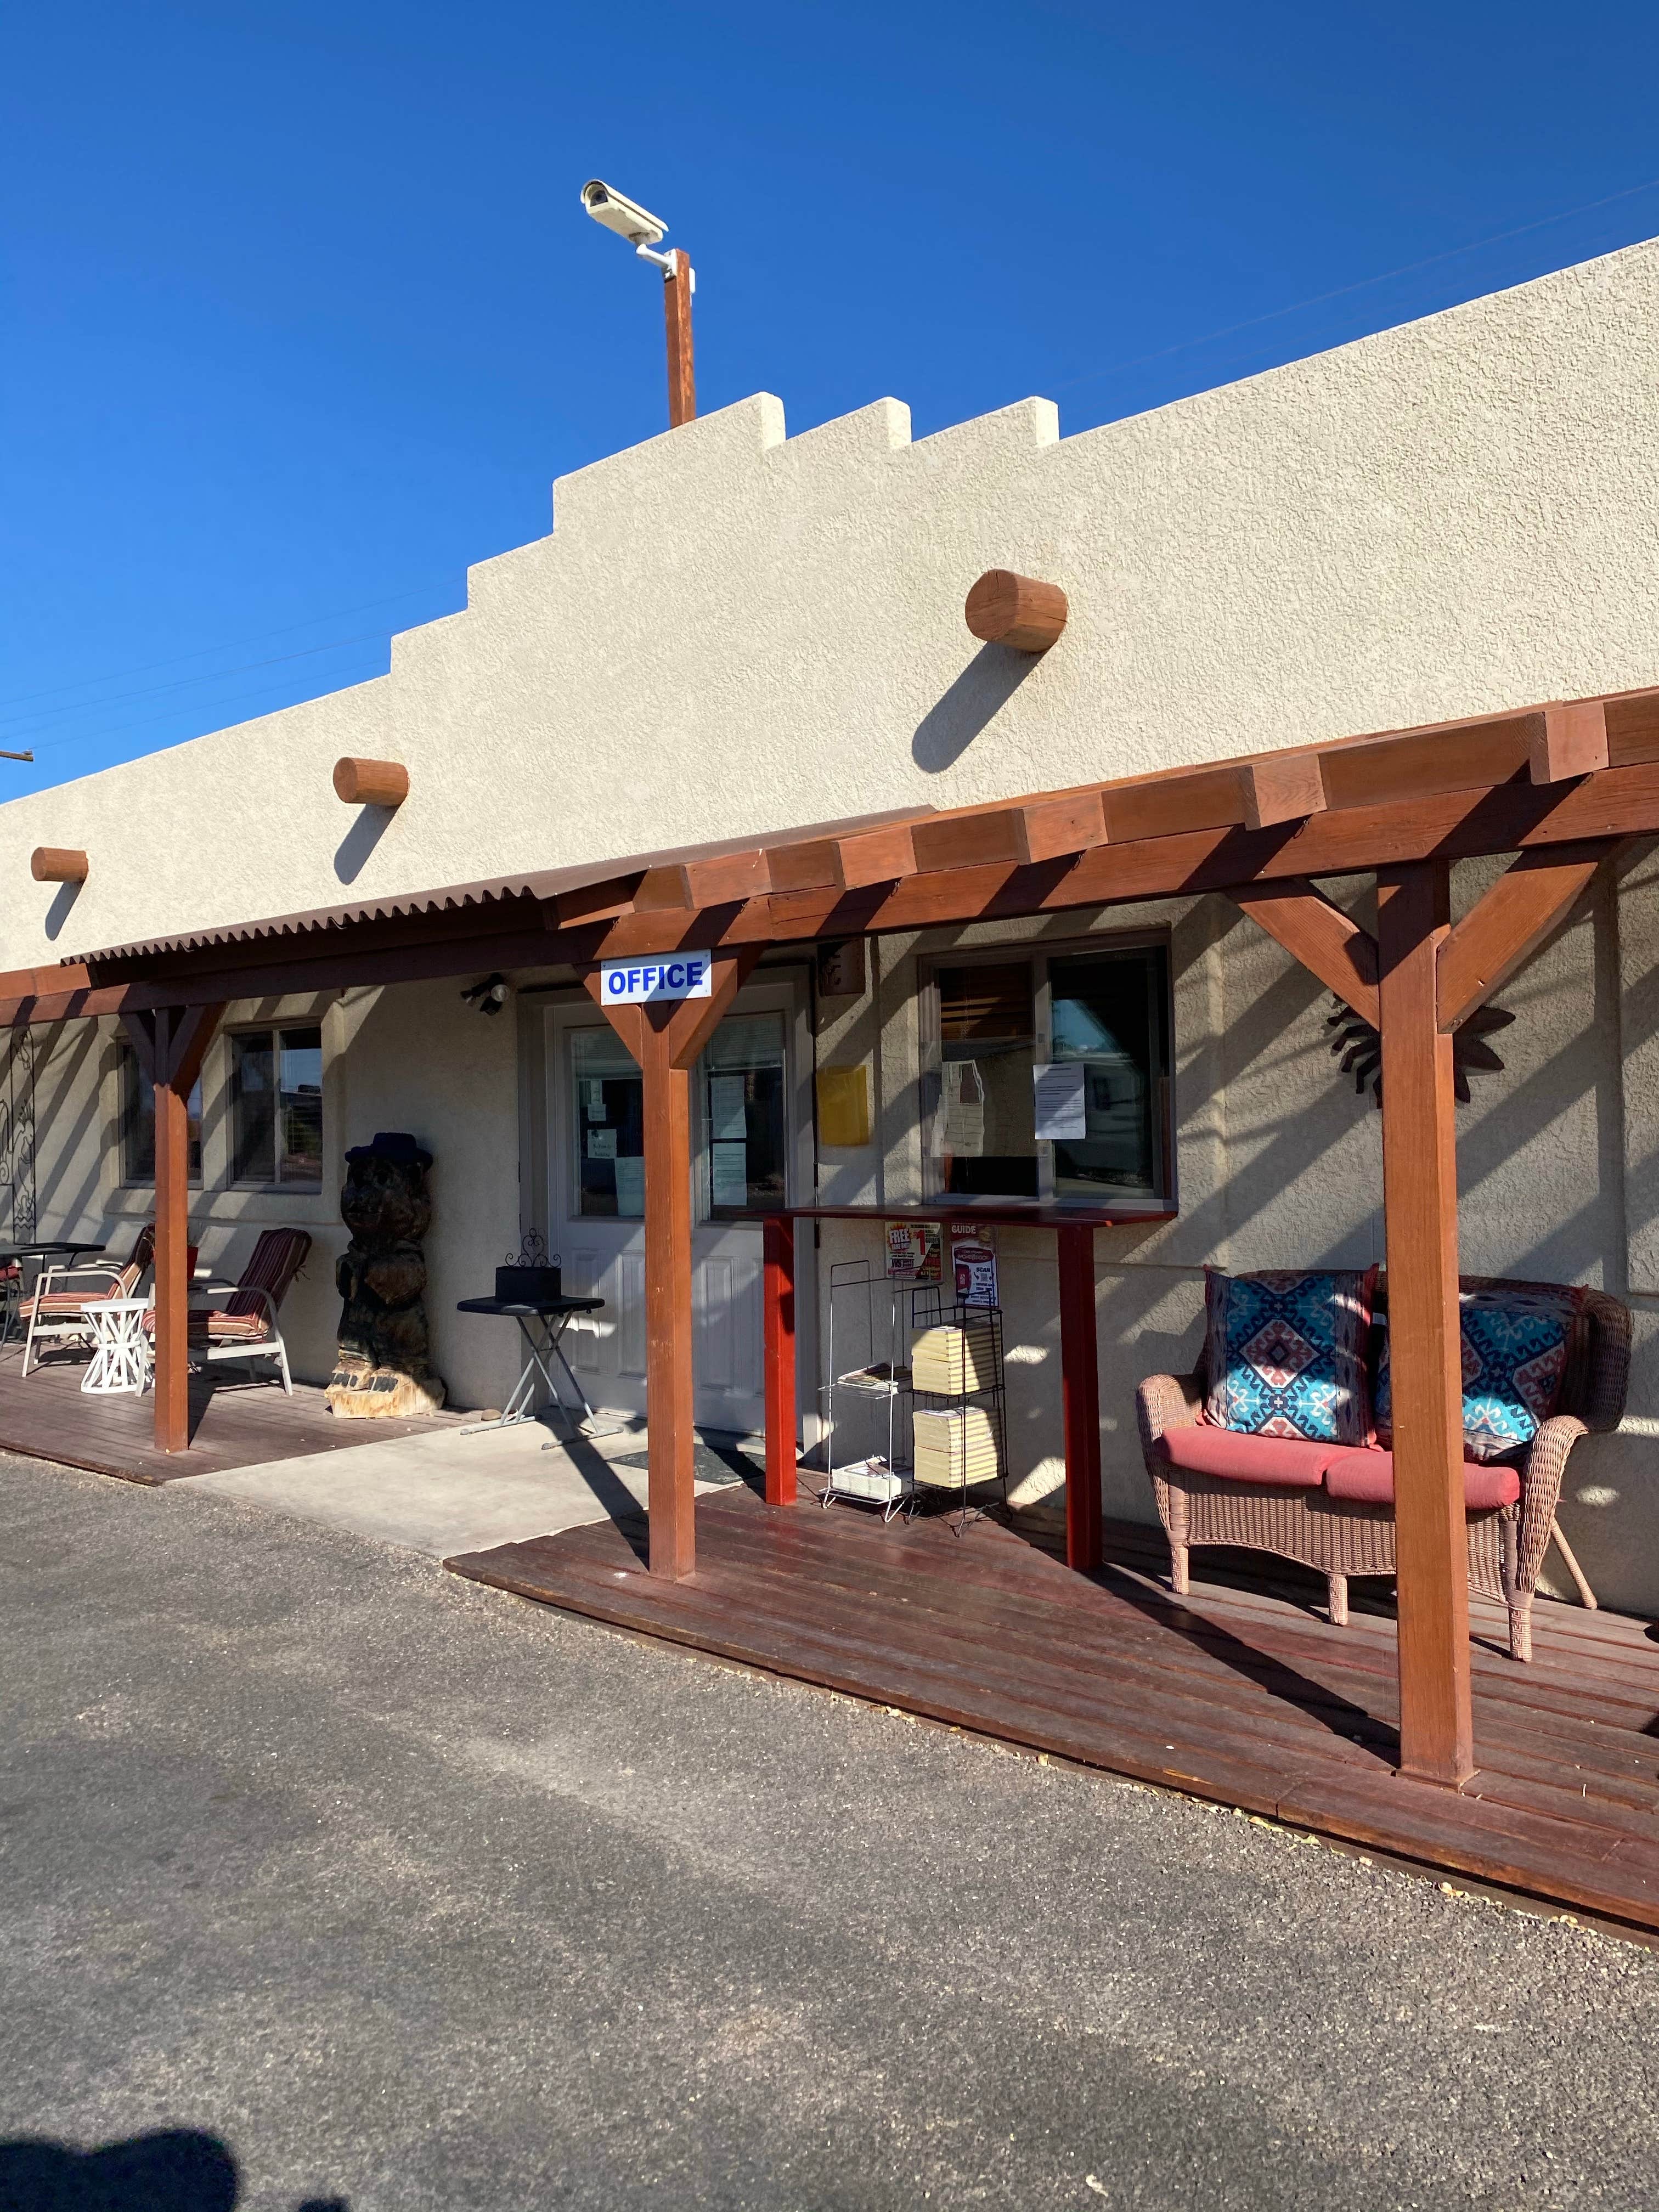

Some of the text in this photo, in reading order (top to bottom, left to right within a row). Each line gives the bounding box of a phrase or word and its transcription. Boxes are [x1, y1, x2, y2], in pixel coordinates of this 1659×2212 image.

[608, 961, 703, 995] OFFICE
[889, 1228, 911, 1244] FREE
[951, 1224, 977, 1234] GUIDE
